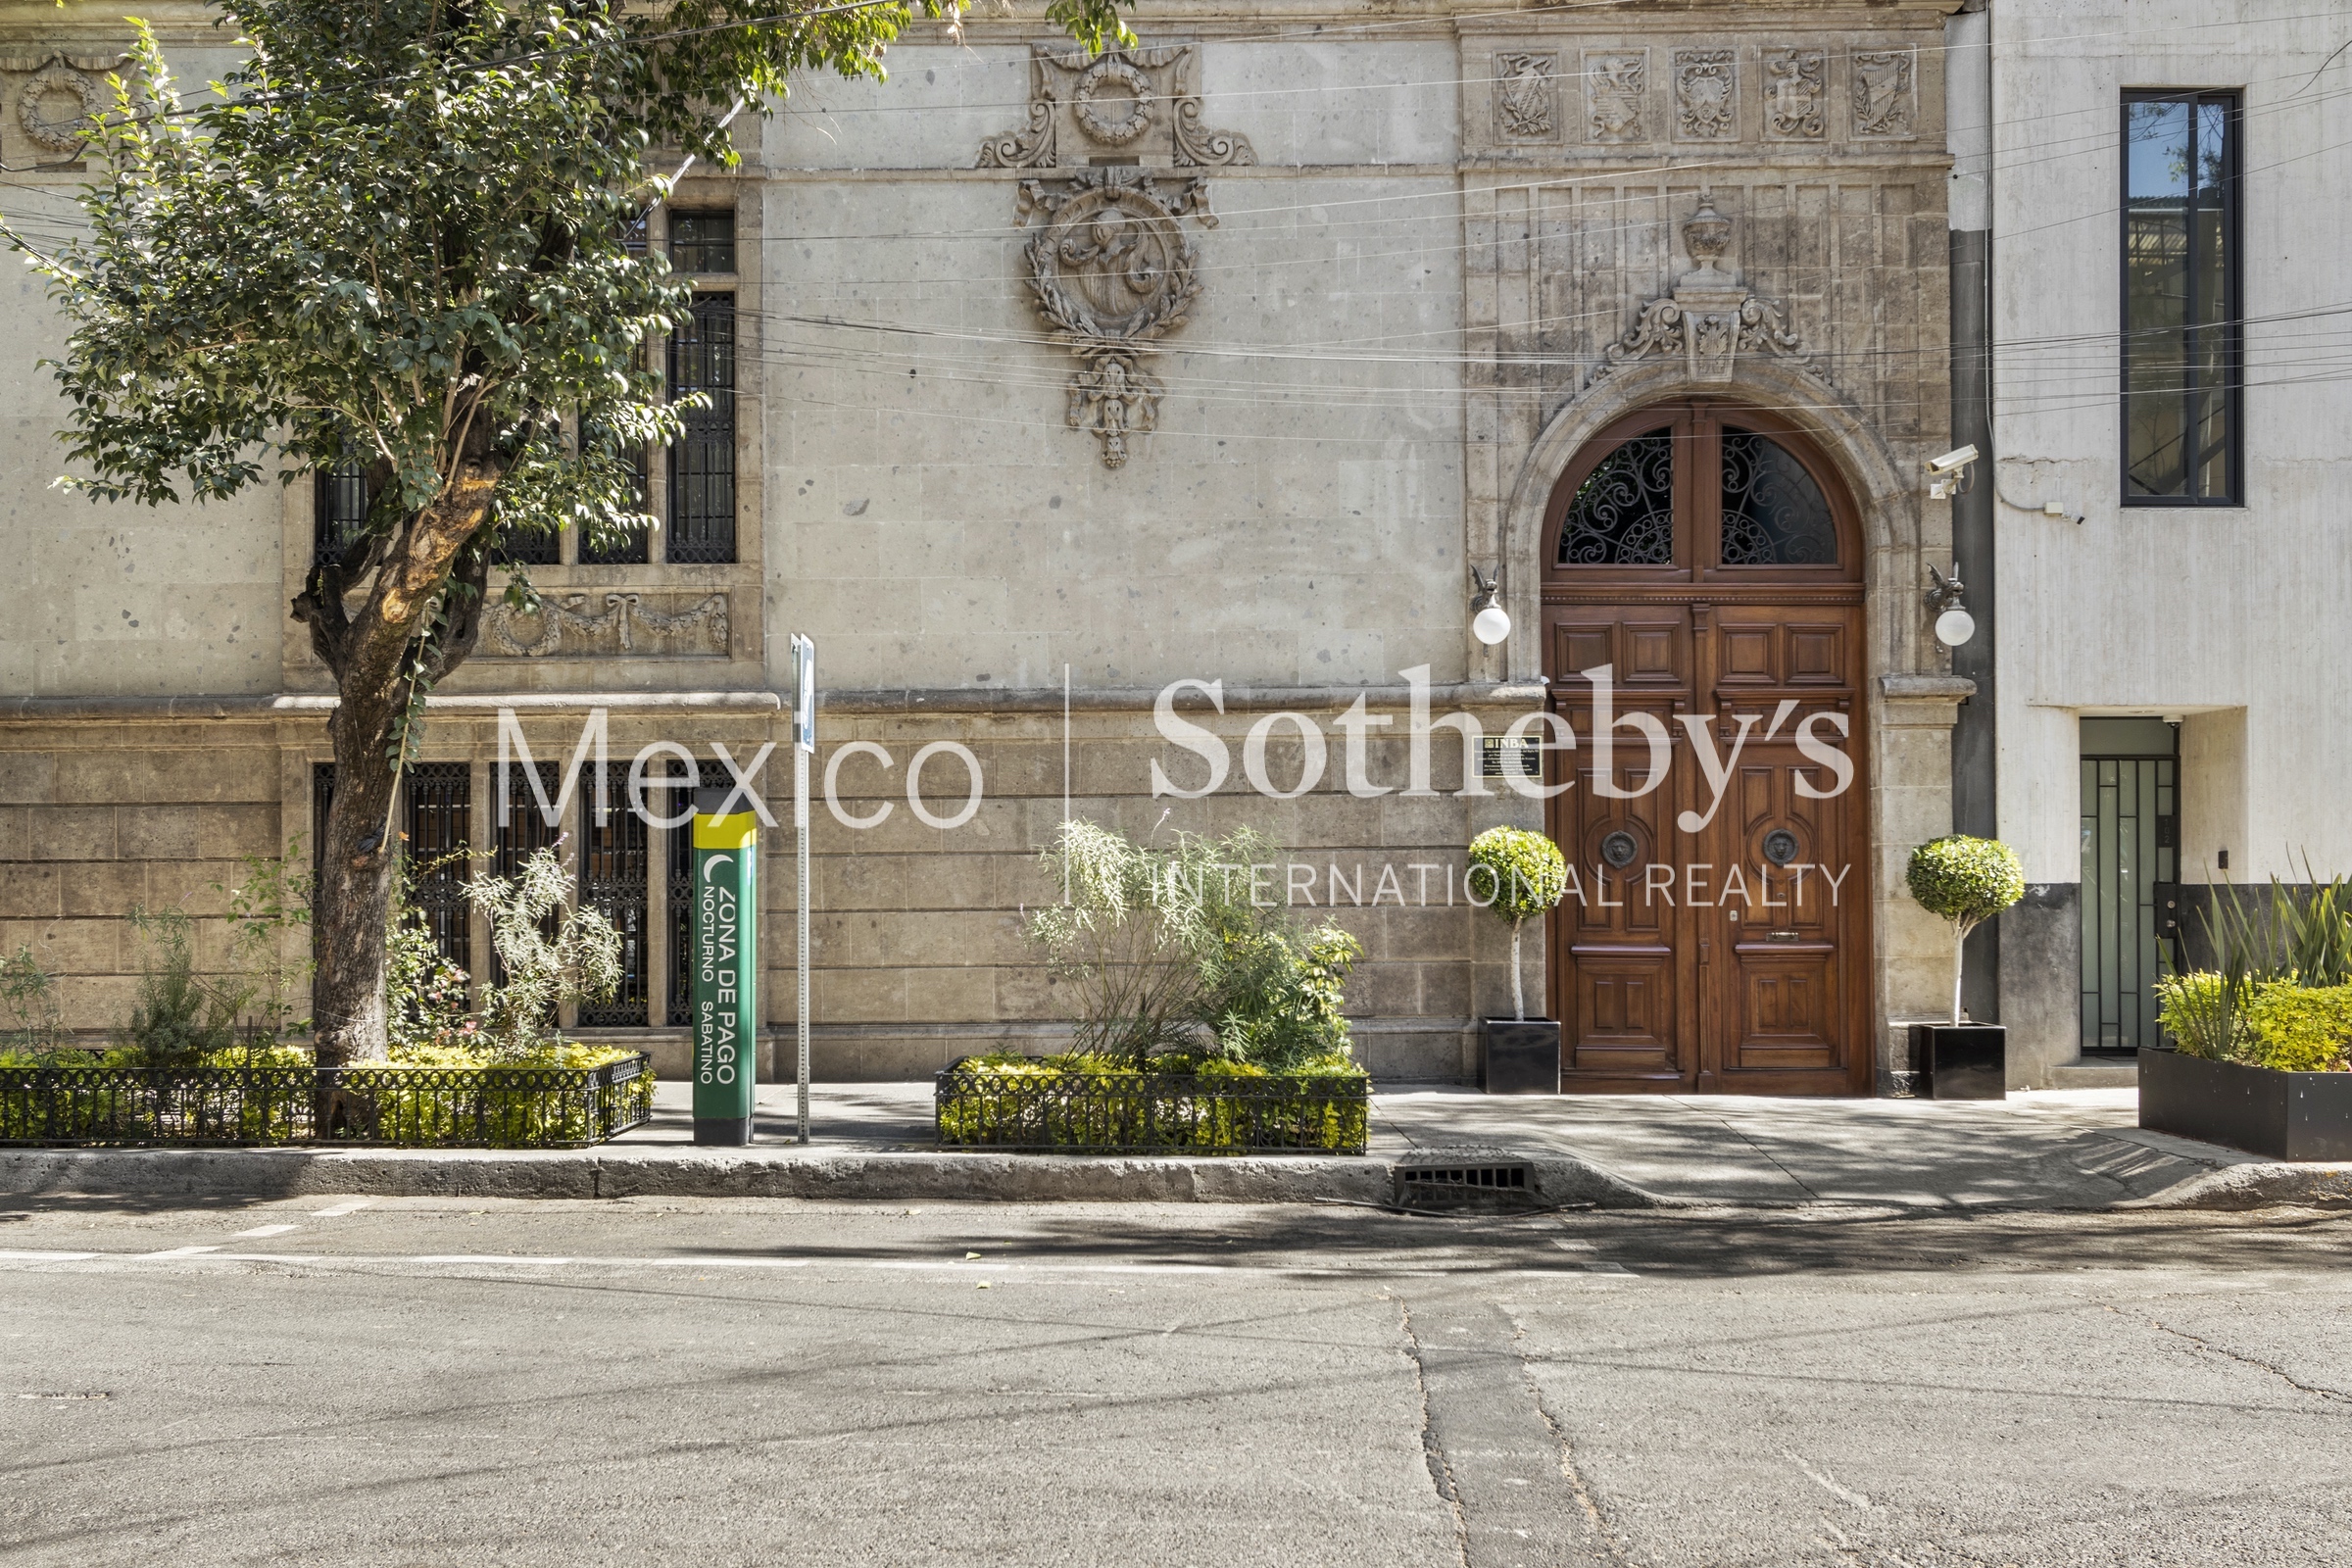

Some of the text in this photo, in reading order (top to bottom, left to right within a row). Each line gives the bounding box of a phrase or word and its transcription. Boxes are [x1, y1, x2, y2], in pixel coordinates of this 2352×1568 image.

[1494, 738, 1529, 749] INBA
[701, 886, 715, 1084] NOCTURNO SABATINO
[716, 886, 736, 1085] ZONA DE PAGO
